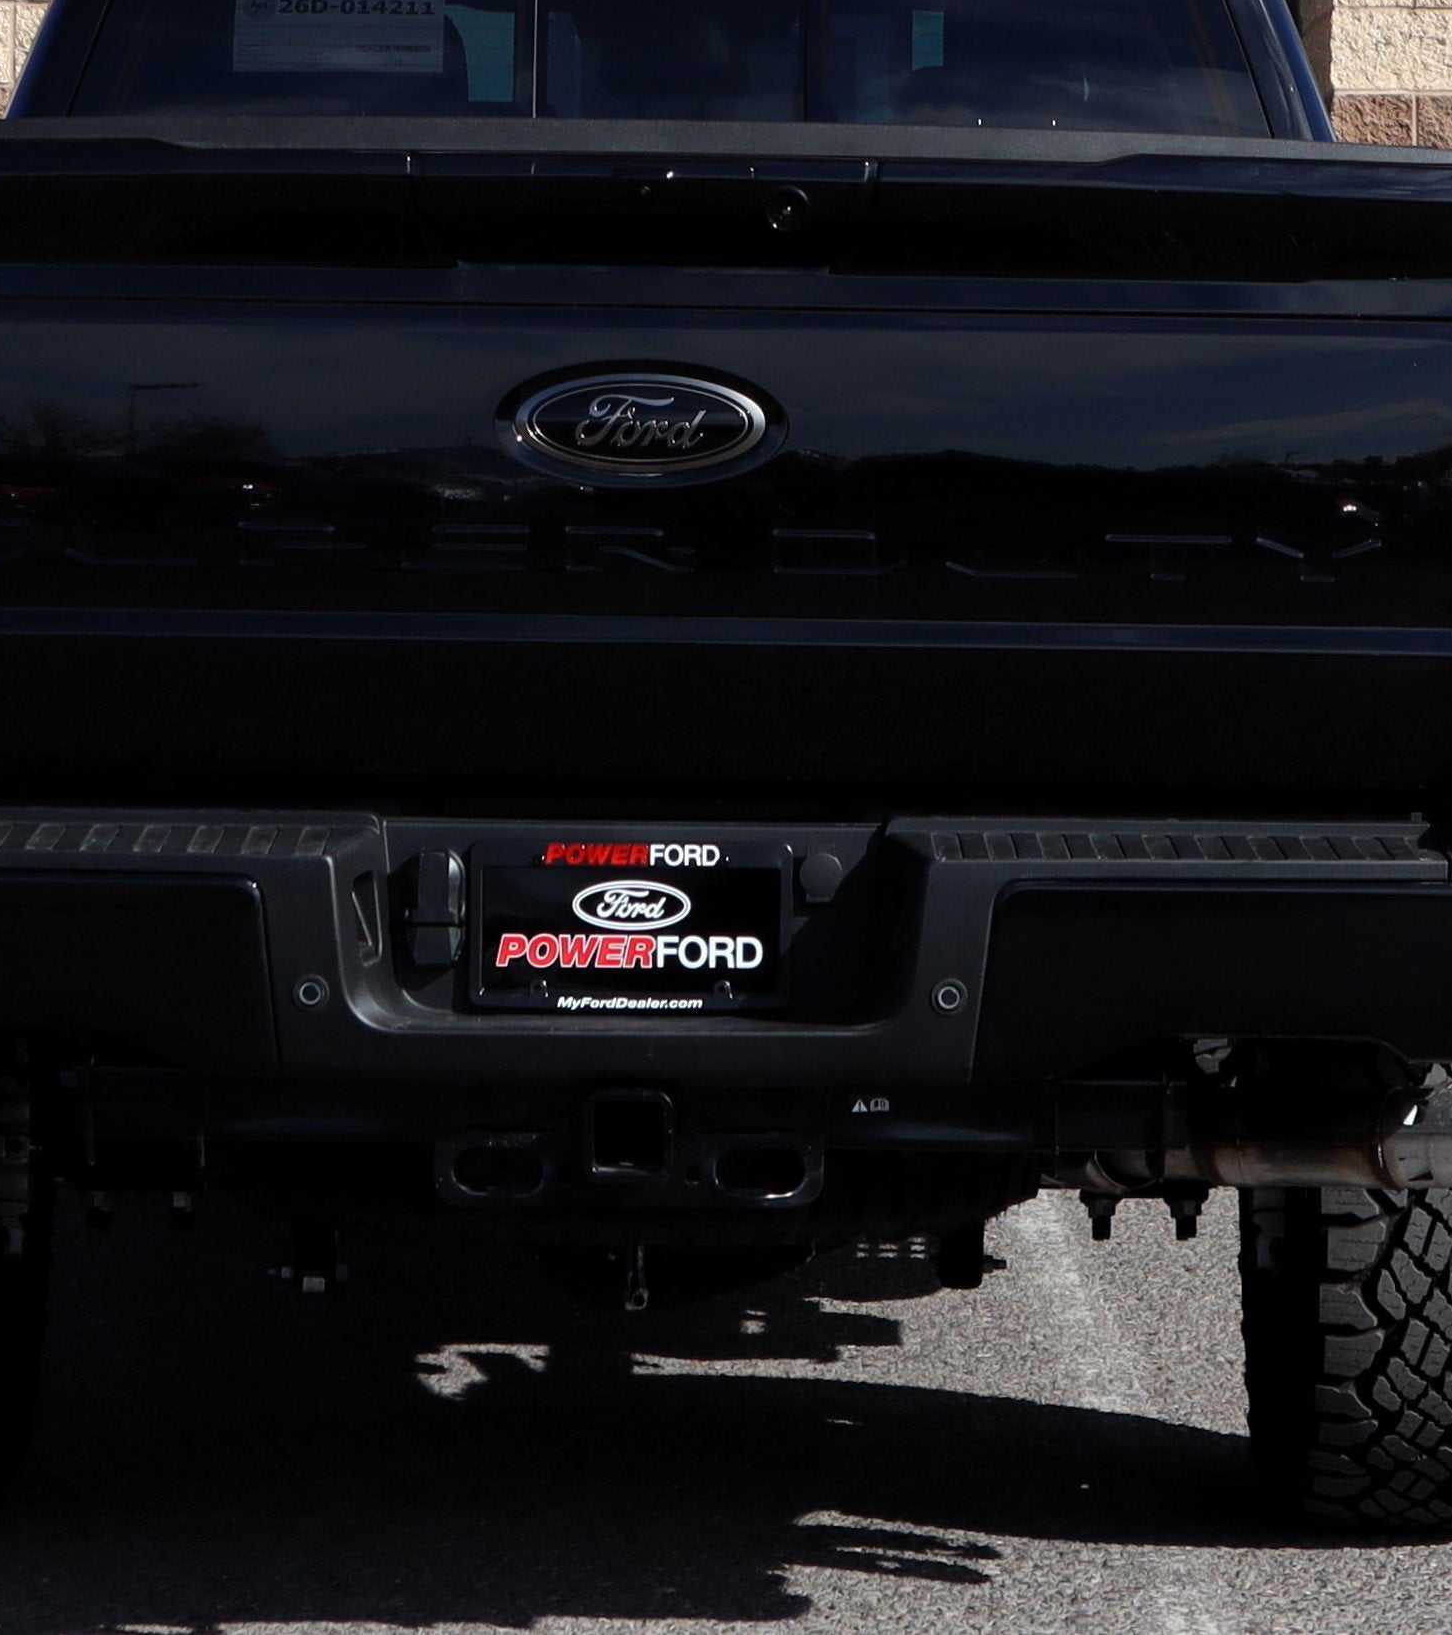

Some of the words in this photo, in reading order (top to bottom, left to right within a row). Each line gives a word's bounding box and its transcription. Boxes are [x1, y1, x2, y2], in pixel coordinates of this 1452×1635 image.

[575, 393, 707, 448] Ford
[545, 842, 721, 866] POWERFORD
[596, 889, 668, 920] Ford
[495, 933, 764, 968] POWERFORD
[557, 995, 703, 1010] MyFordDealer.com
